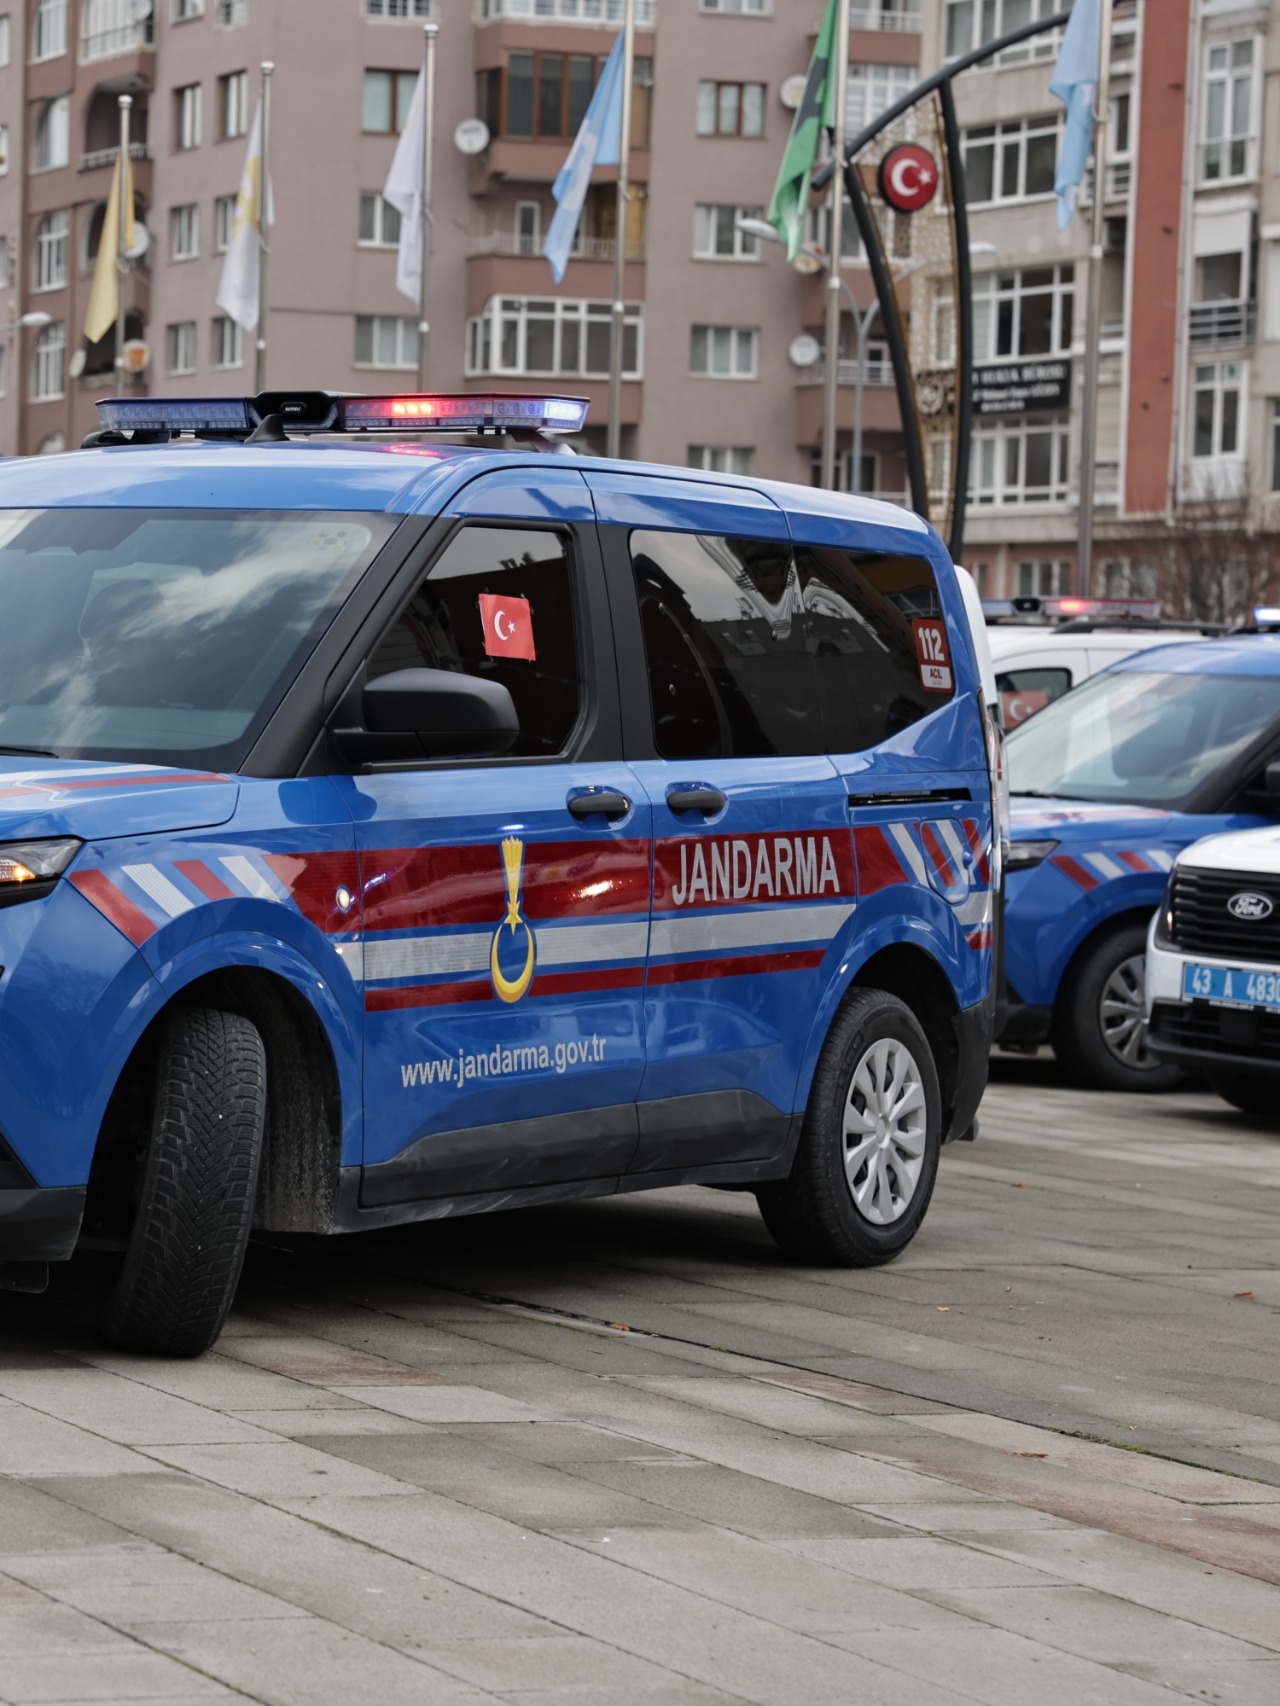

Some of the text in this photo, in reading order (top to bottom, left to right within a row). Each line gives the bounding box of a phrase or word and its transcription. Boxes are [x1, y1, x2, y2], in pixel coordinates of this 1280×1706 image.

[918, 627, 945, 661] 112
[672, 836, 841, 905] JANDARMA
[1235, 896, 1265, 916] Ford
[1192, 967, 1212, 995] 43
[1223, 971, 1233, 998] A
[401, 1033, 607, 1088] www.jandarma.gov.tr
